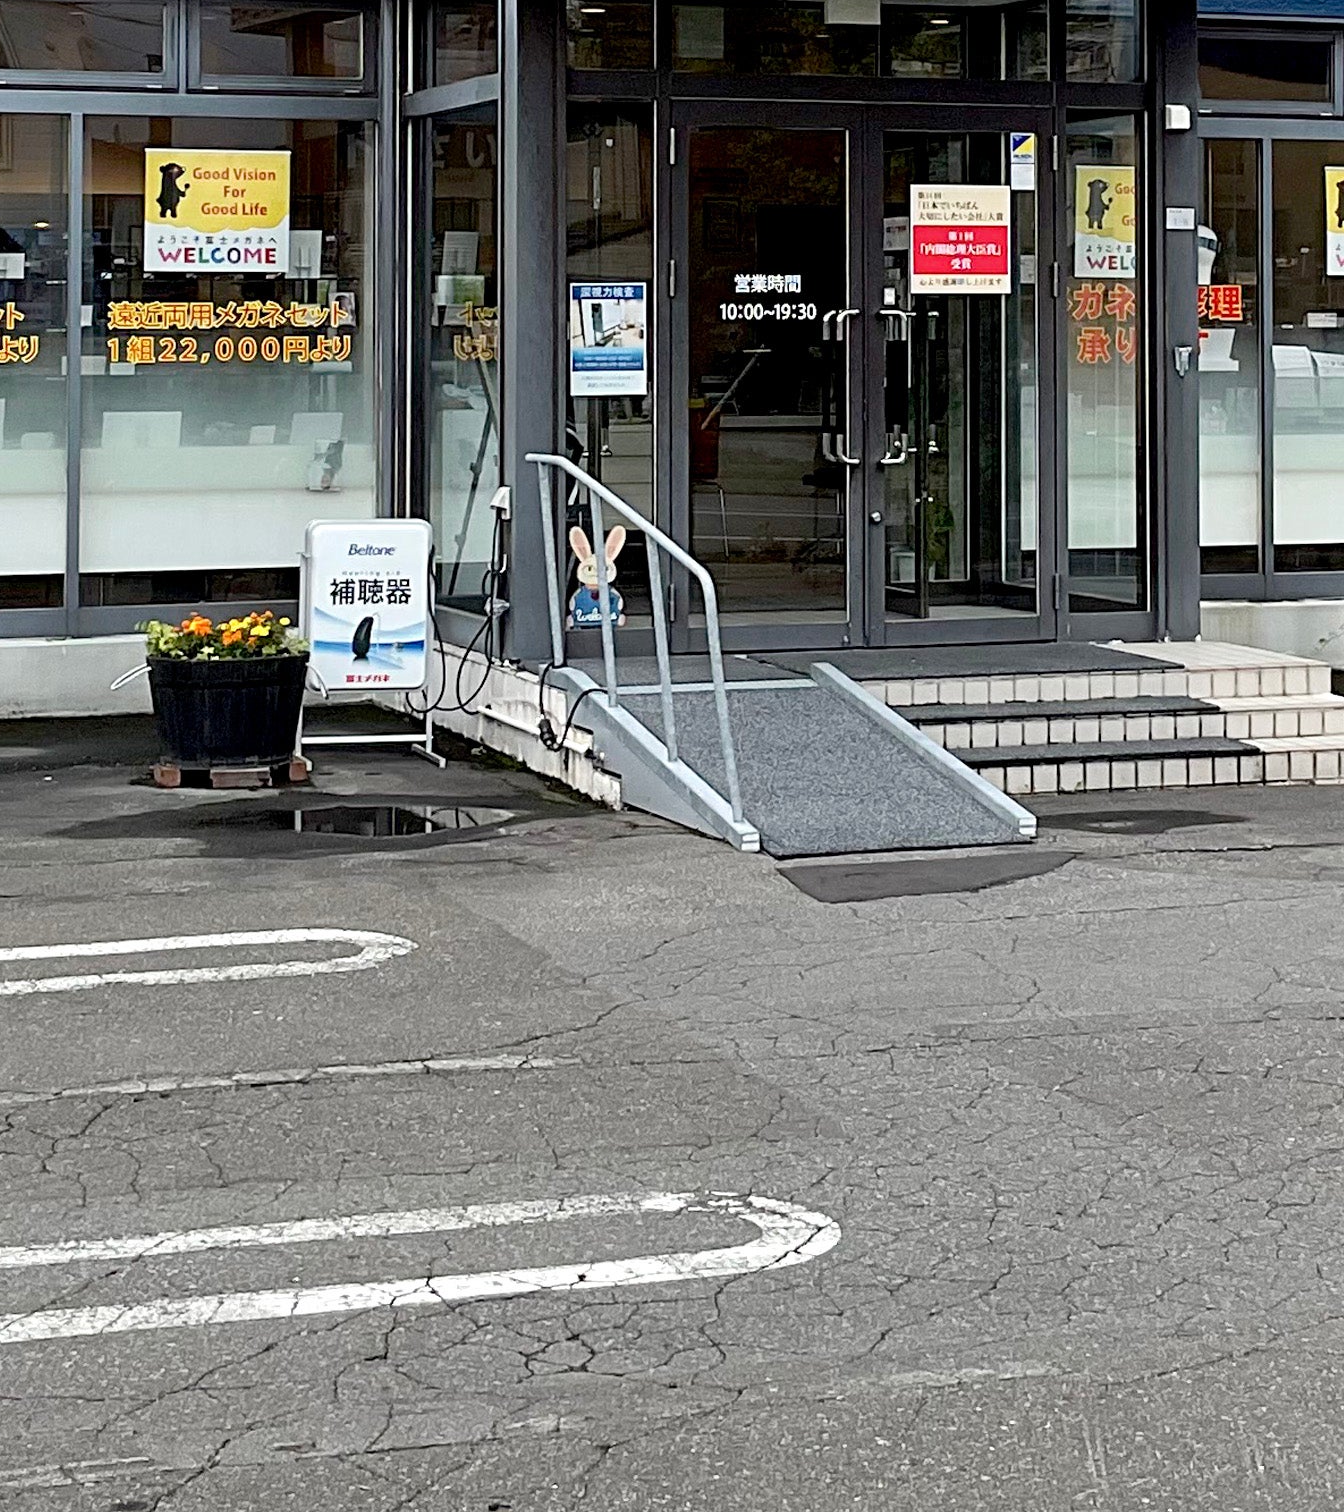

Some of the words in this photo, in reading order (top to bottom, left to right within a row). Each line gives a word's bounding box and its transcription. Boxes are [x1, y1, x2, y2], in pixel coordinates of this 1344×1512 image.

[192, 167, 229, 180] Good
[233, 168, 276, 181] Vision
[223, 186, 246, 198] For
[201, 202, 238, 215] Good
[242, 203, 268, 215] Life
[158, 247, 276, 264] WELCOME
[734, 274, 801, 293] 営業時間
[1067, 283, 1135, 321] ガネ
[108, 301, 349, 330] 遠近両用メガネセット
[348, 544, 396, 556] Beltone
[330, 578, 412, 605] 補聴器
